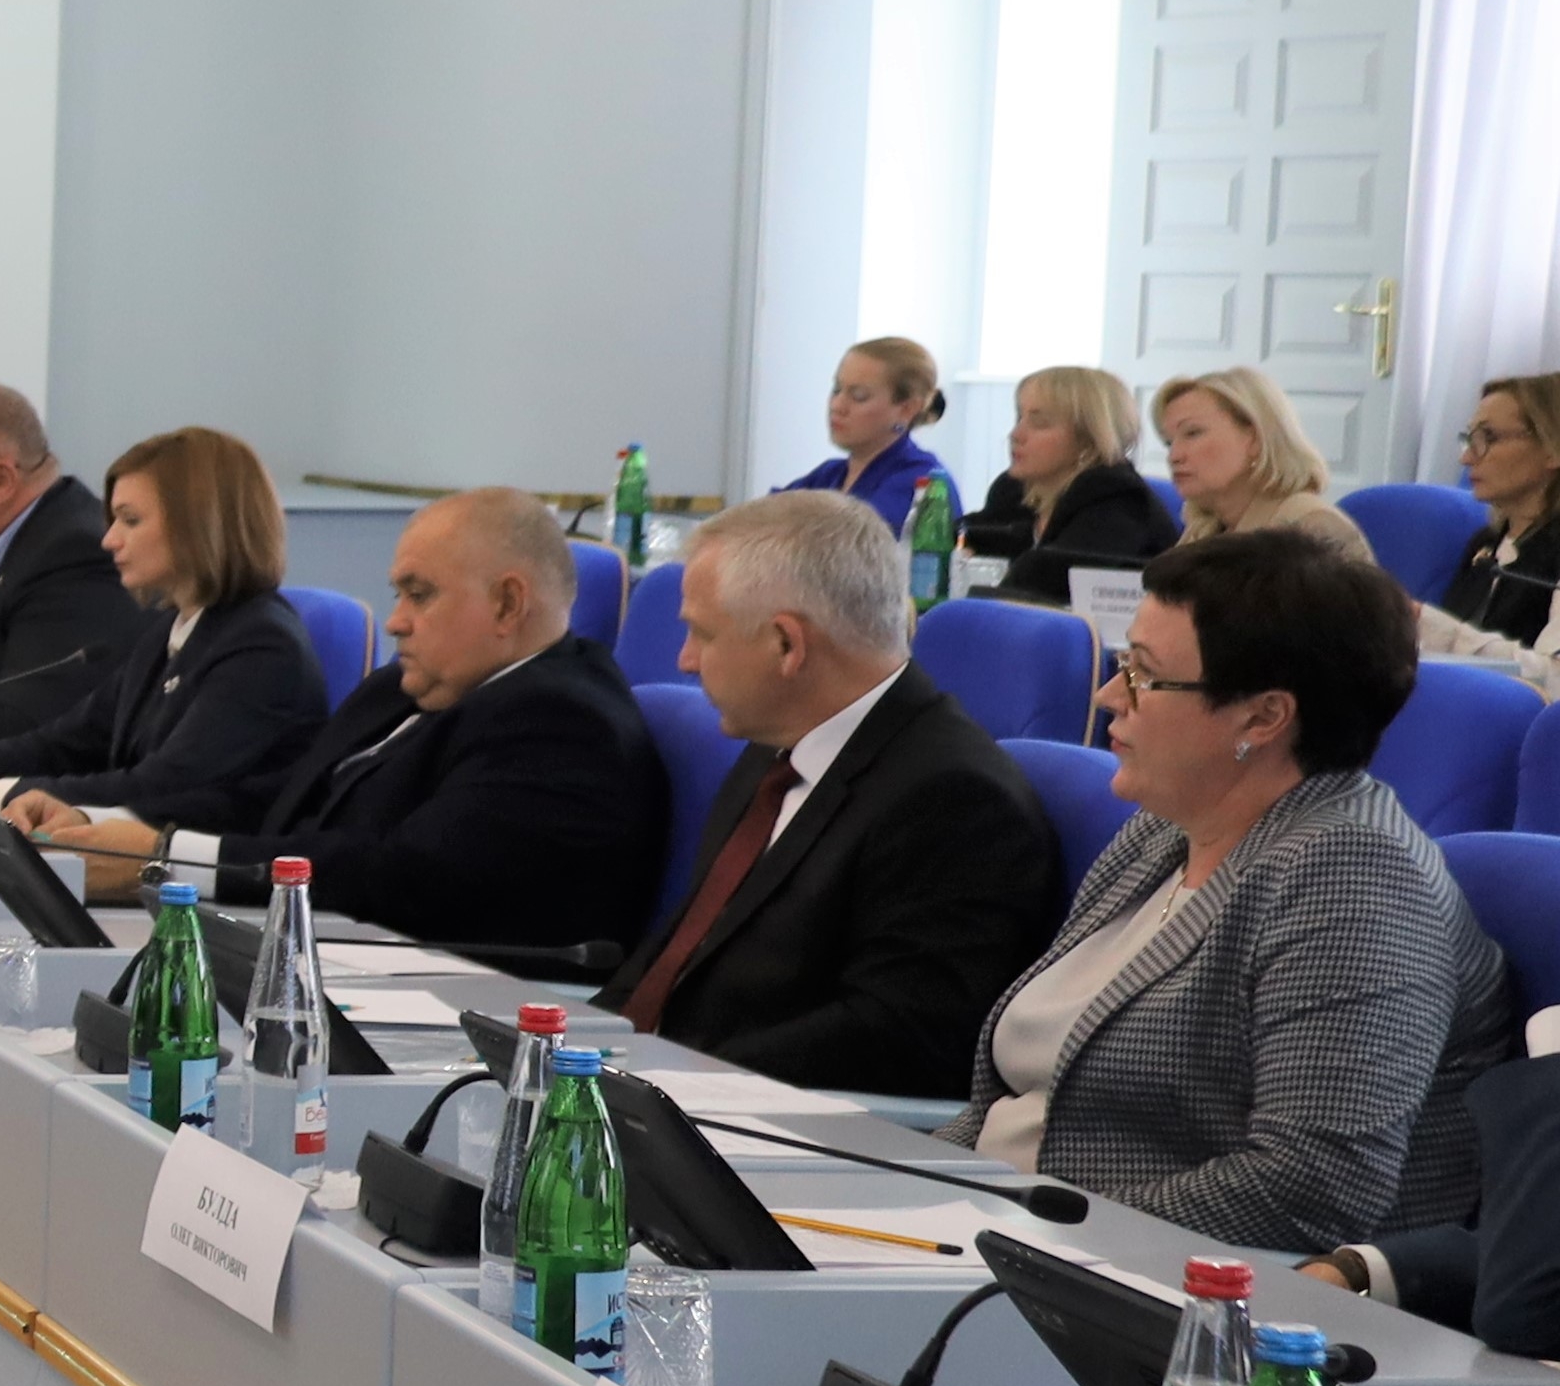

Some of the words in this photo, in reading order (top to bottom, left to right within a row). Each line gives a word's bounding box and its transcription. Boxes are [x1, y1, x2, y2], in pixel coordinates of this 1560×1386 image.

[197, 1186, 239, 1230] БУЛДА
[170, 1222, 192, 1247] ОЛЕГ
[192, 1234, 248, 1282] ВИКТОРОВИЧ
